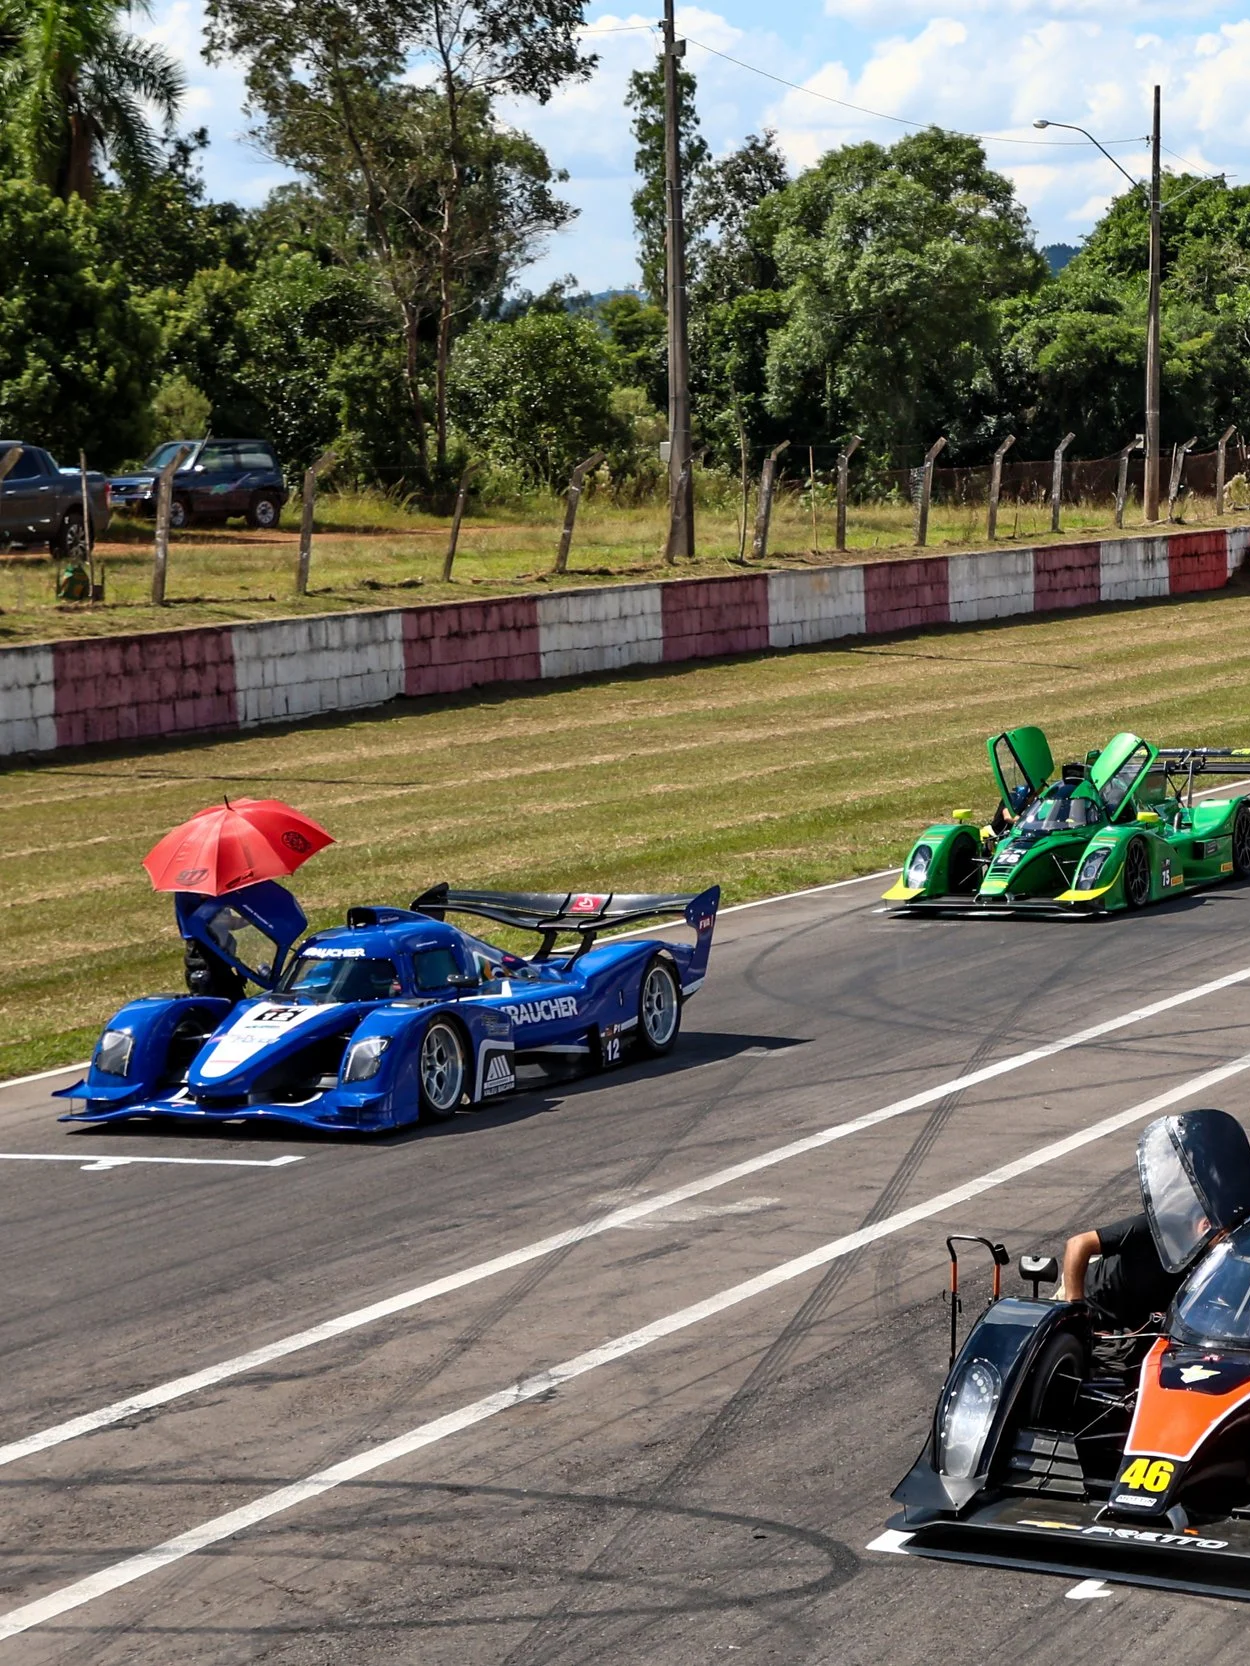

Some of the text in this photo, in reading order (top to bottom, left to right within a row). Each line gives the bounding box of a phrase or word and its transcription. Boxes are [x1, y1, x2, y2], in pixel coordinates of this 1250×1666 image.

[1162, 869, 1171, 887] 75
[606, 1037, 620, 1062] 12
[1119, 1458, 1175, 1493] 46
[1082, 1526, 1229, 1549] PRETTO
